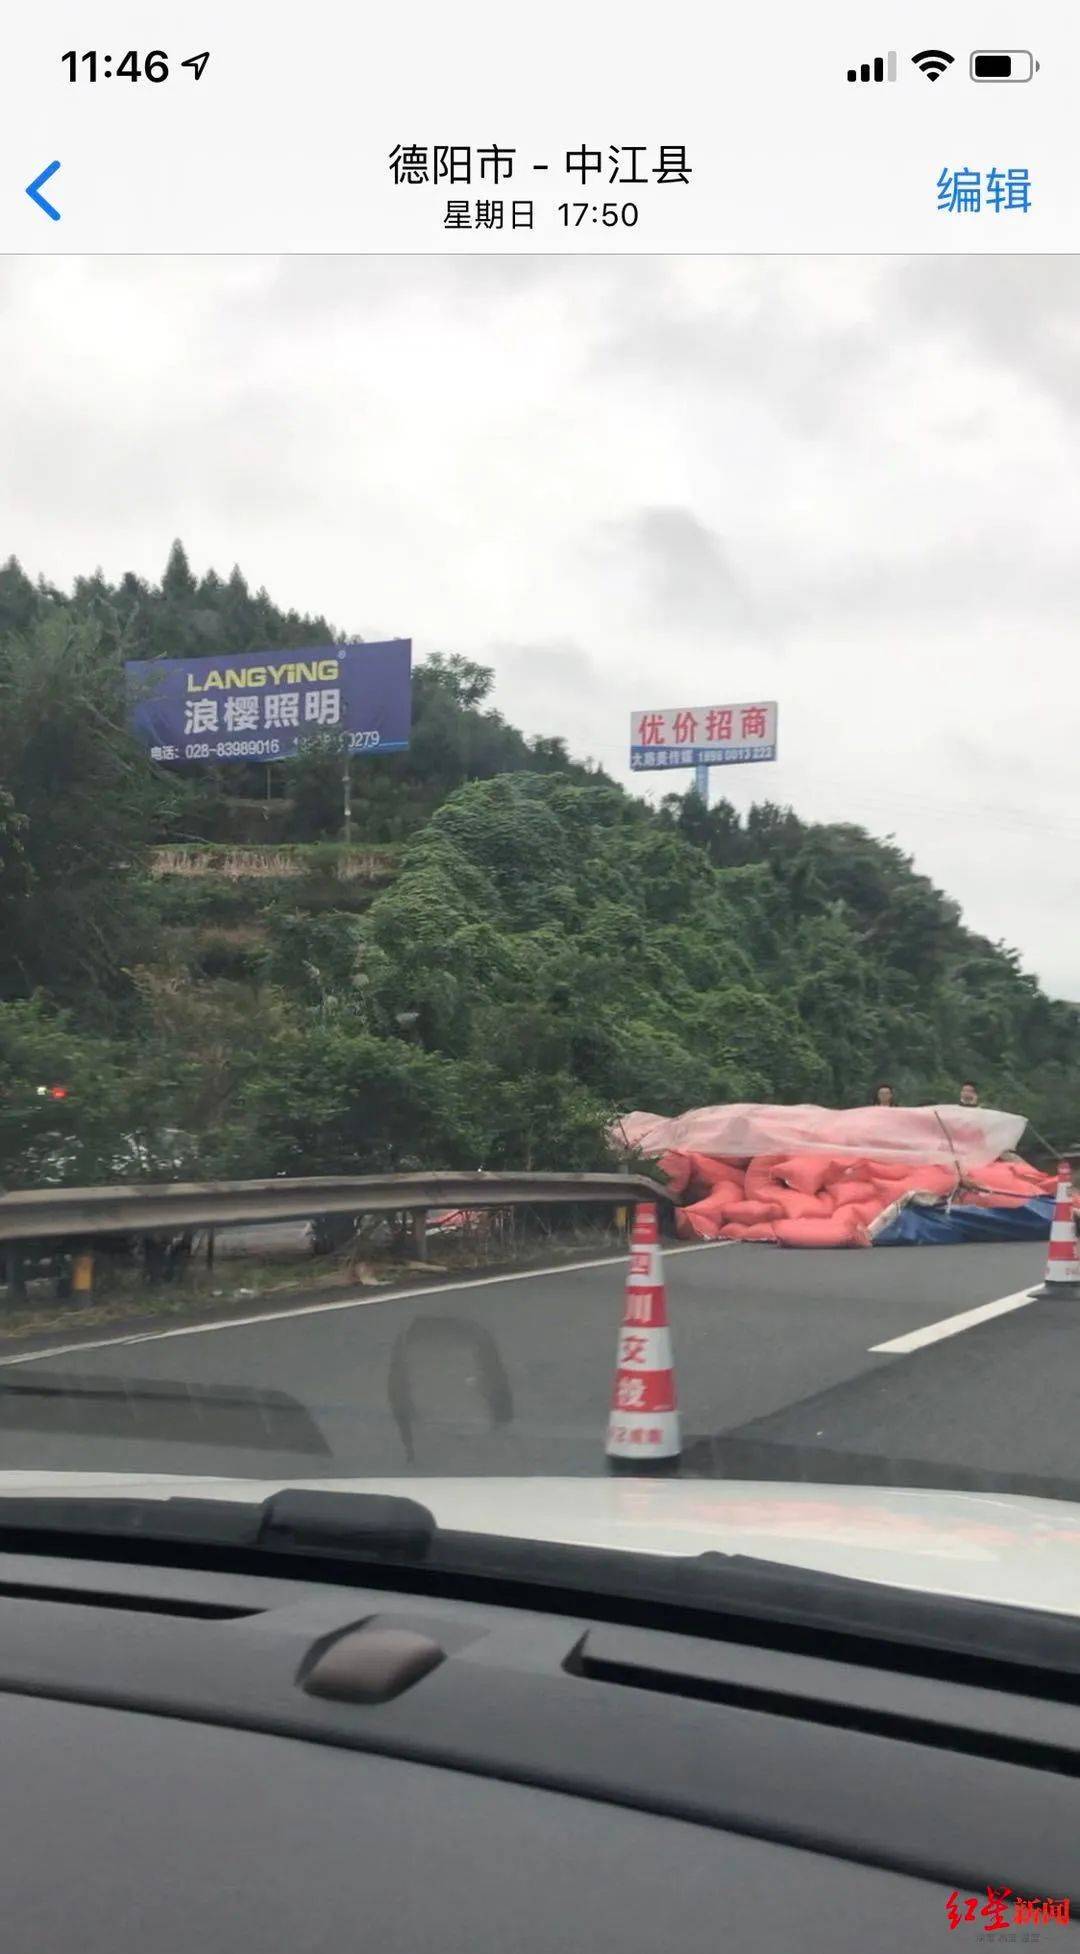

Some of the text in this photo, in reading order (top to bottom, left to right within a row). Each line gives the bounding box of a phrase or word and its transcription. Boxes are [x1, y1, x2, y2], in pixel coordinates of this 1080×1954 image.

[183, 689, 340, 735] 浪樱照明
[638, 705, 768, 745] 优价招商
